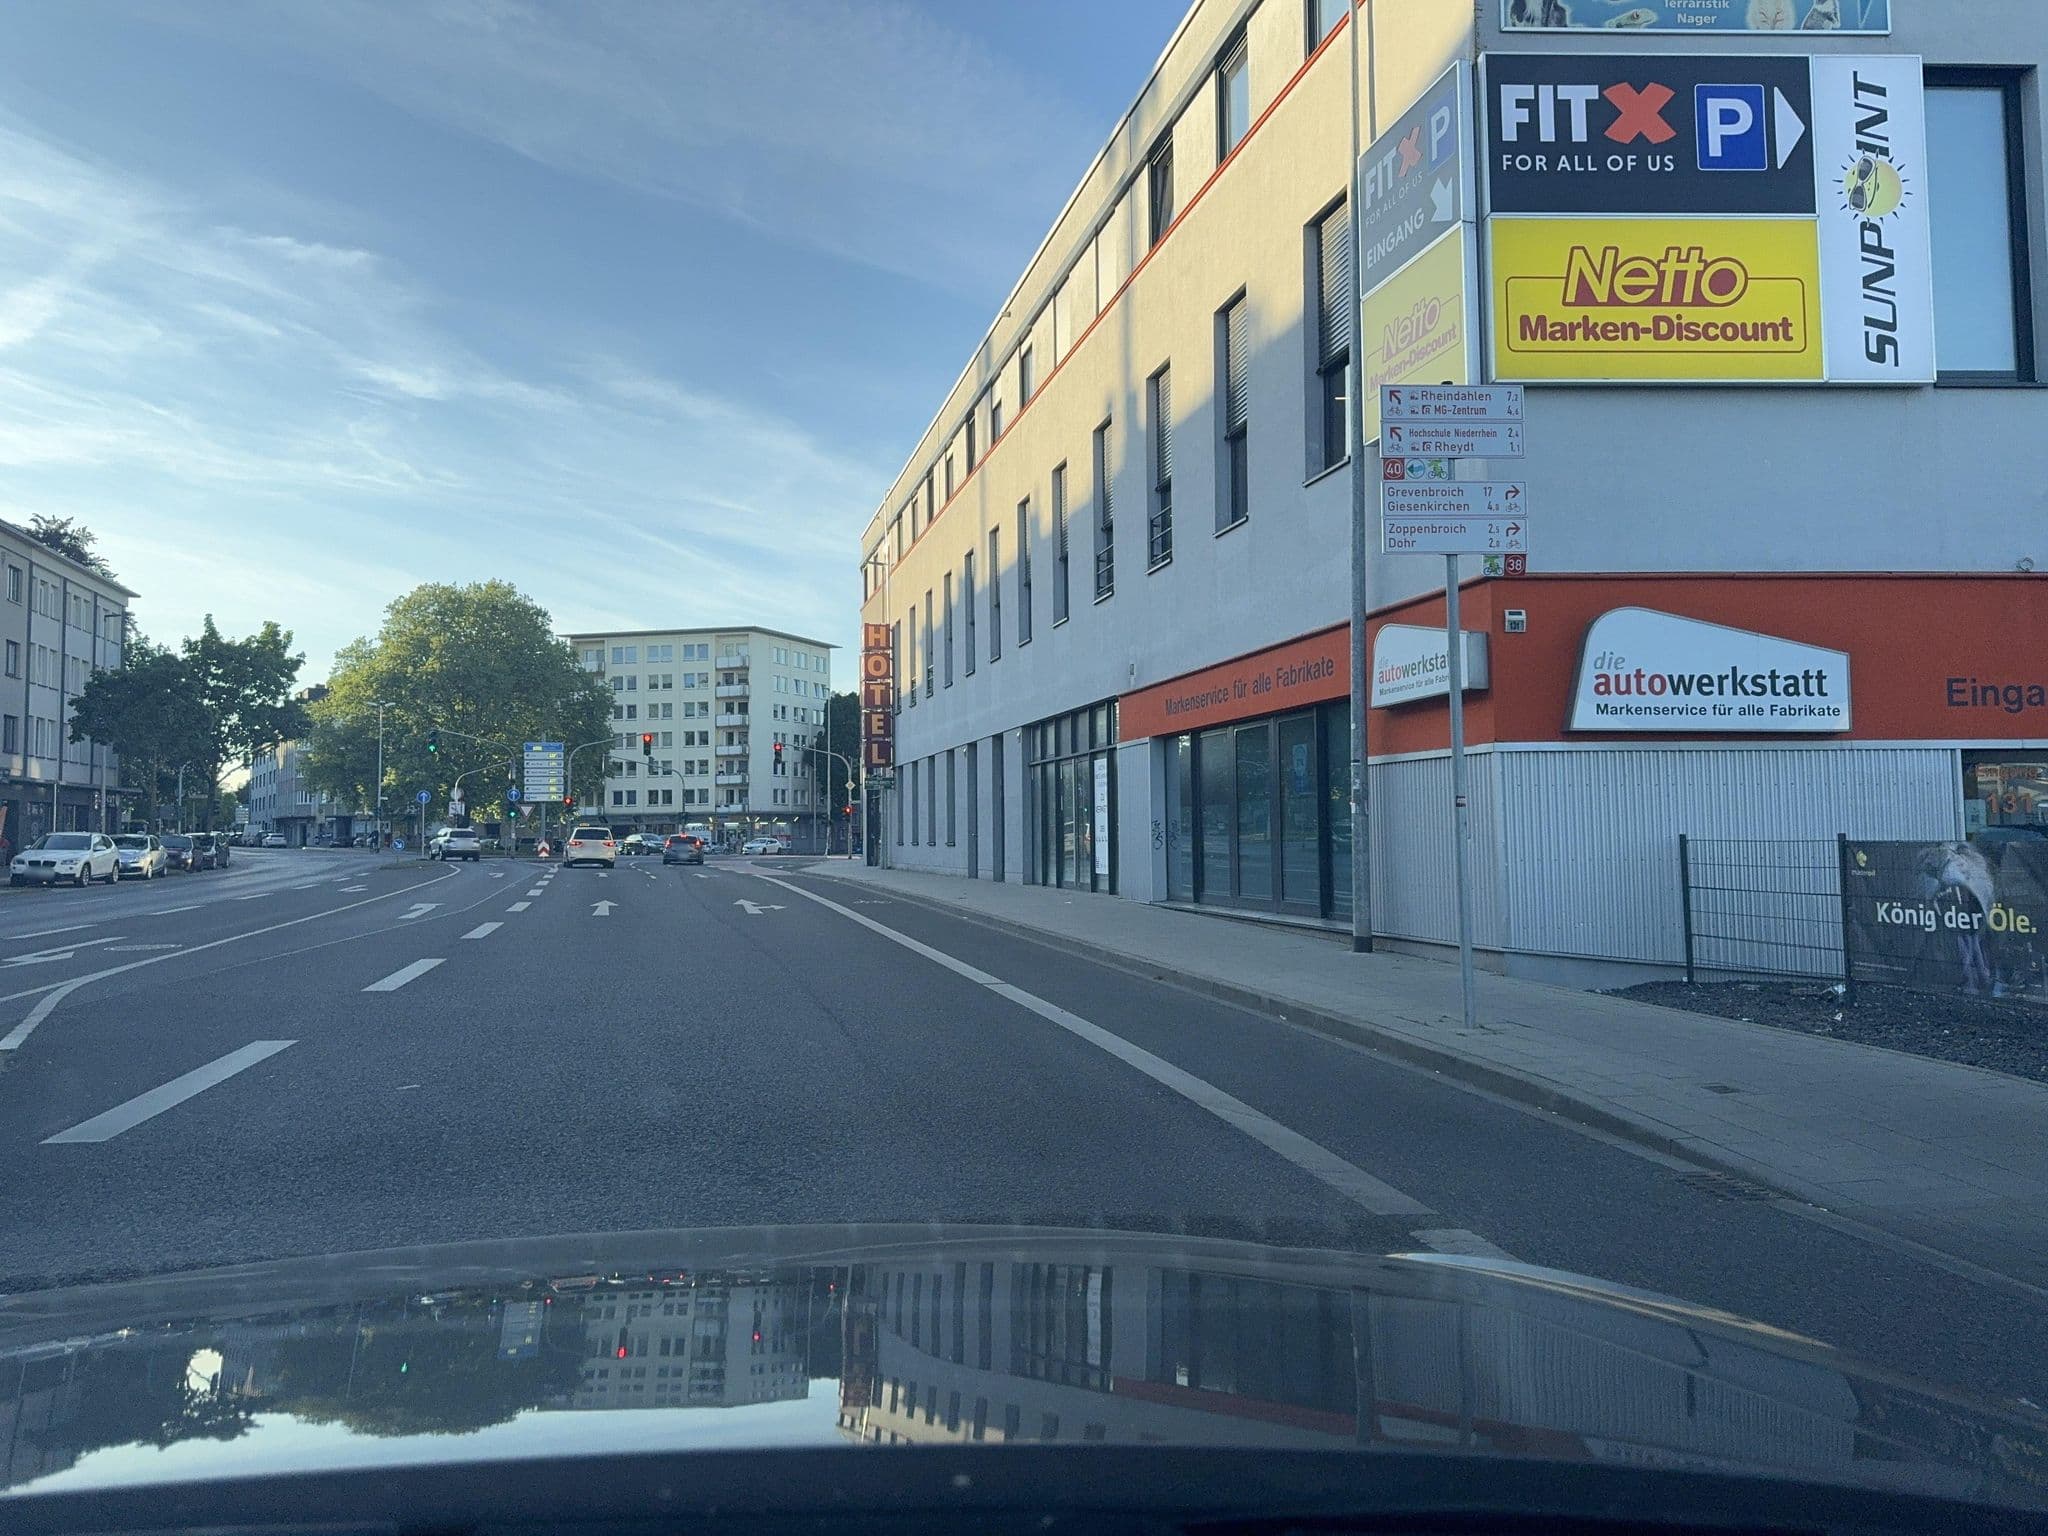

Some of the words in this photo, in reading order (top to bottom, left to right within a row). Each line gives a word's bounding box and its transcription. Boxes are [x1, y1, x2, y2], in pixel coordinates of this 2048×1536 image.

[1677, 13, 1717, 26] Nager
[1500, 82, 1677, 144] FITX
[1706, 98, 1753, 157] P
[1502, 154, 1547, 171] FOR
[1556, 154, 1598, 171] ALL
[1606, 154, 1638, 171] OF
[1647, 154, 1675, 171] US
[1366, 208, 1381, 229] FOR
[1383, 195, 1399, 215] ALL
[1399, 182, 1410, 199] OF
[1412, 170, 1424, 188] US
[1367, 207, 1425, 270] EINGANG
[1562, 246, 1748, 307] Netto
[1382, 296, 1441, 363] Netto
[1519, 314, 1794, 342] Marken-Discount
[1370, 322, 1457, 393] Marken-Discount
[1421, 390, 1492, 401] Rheindahlen
[1434, 405, 1487, 415] MG-Zentrum
[1409, 428, 1451, 438] Hochschule
[1454, 428, 1497, 438] Niederrhein
[1435, 442, 1474, 454] Rheydt
[1386, 463, 1401, 475] 40
[1387, 487, 1464, 497] Grevenbroich
[1483, 487, 1492, 497] 17
[1387, 501, 1470, 511] Giesenkirchen
[1388, 523, 1467, 536] Zoppenbroich
[1388, 538, 1417, 548] Dohr
[1508, 561, 1522, 570] 38
[1593, 651, 1626, 670] die
[1165, 686, 1229, 715] Markenservice
[1233, 679, 1247, 699] für
[1252, 672, 1271, 694] alle
[1276, 656, 1334, 689] Fabrikate
[1593, 666, 1828, 697] autowerkstatt
[867, 626, 888, 764] HOTEL
[1595, 703, 1707, 716] Markenservice
[1712, 703, 1733, 716] für
[1738, 704, 1764, 716] alle
[1770, 704, 1841, 717] Fabrikate
[1876, 902, 1937, 932] König
[1944, 906, 1982, 930] der
[1989, 902, 2038, 933] Öle.
